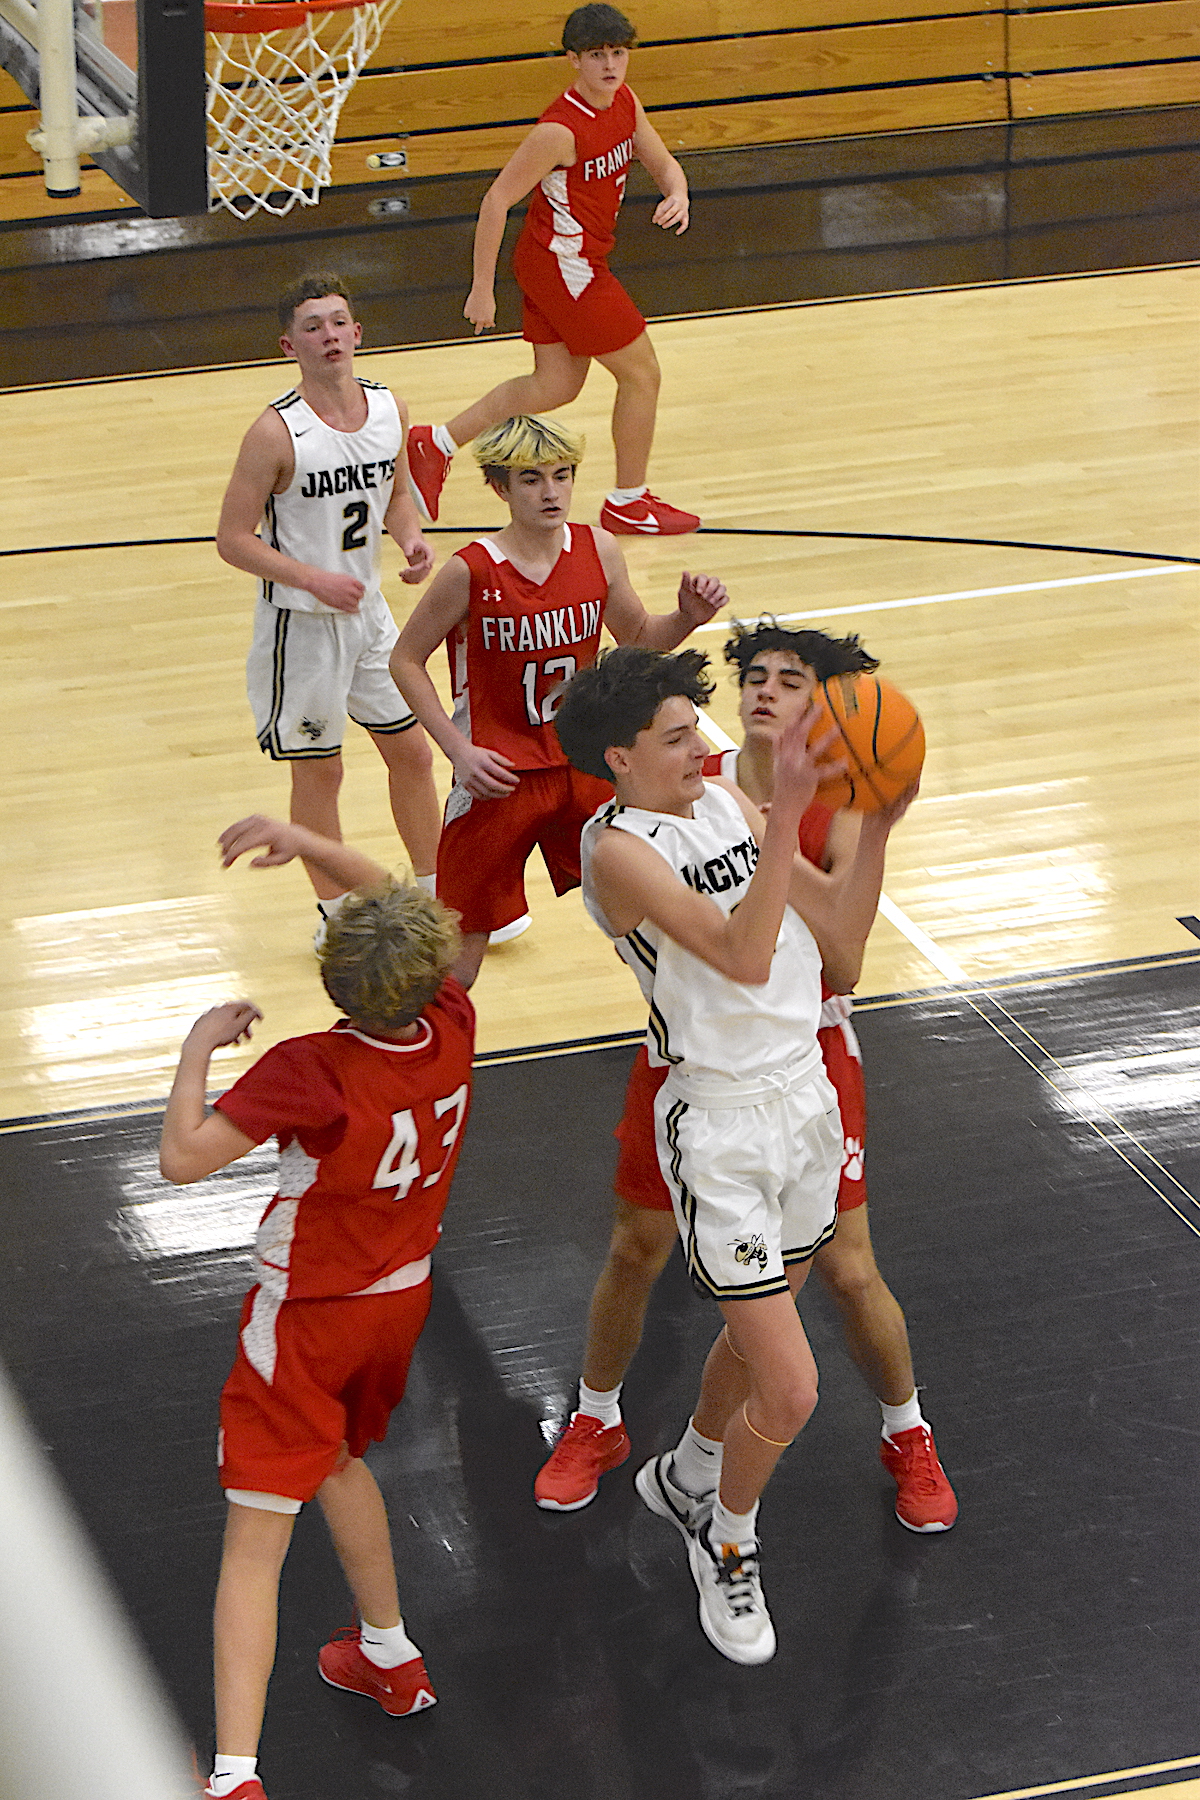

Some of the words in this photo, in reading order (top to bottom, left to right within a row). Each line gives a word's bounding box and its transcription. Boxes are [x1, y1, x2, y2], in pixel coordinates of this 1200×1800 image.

[301, 458, 396, 498] JACKETS
[341, 500, 370, 551] 2
[481, 599, 601, 652] FRANKLIN
[521, 655, 576, 727] 12
[370, 1083, 469, 1201] 43
